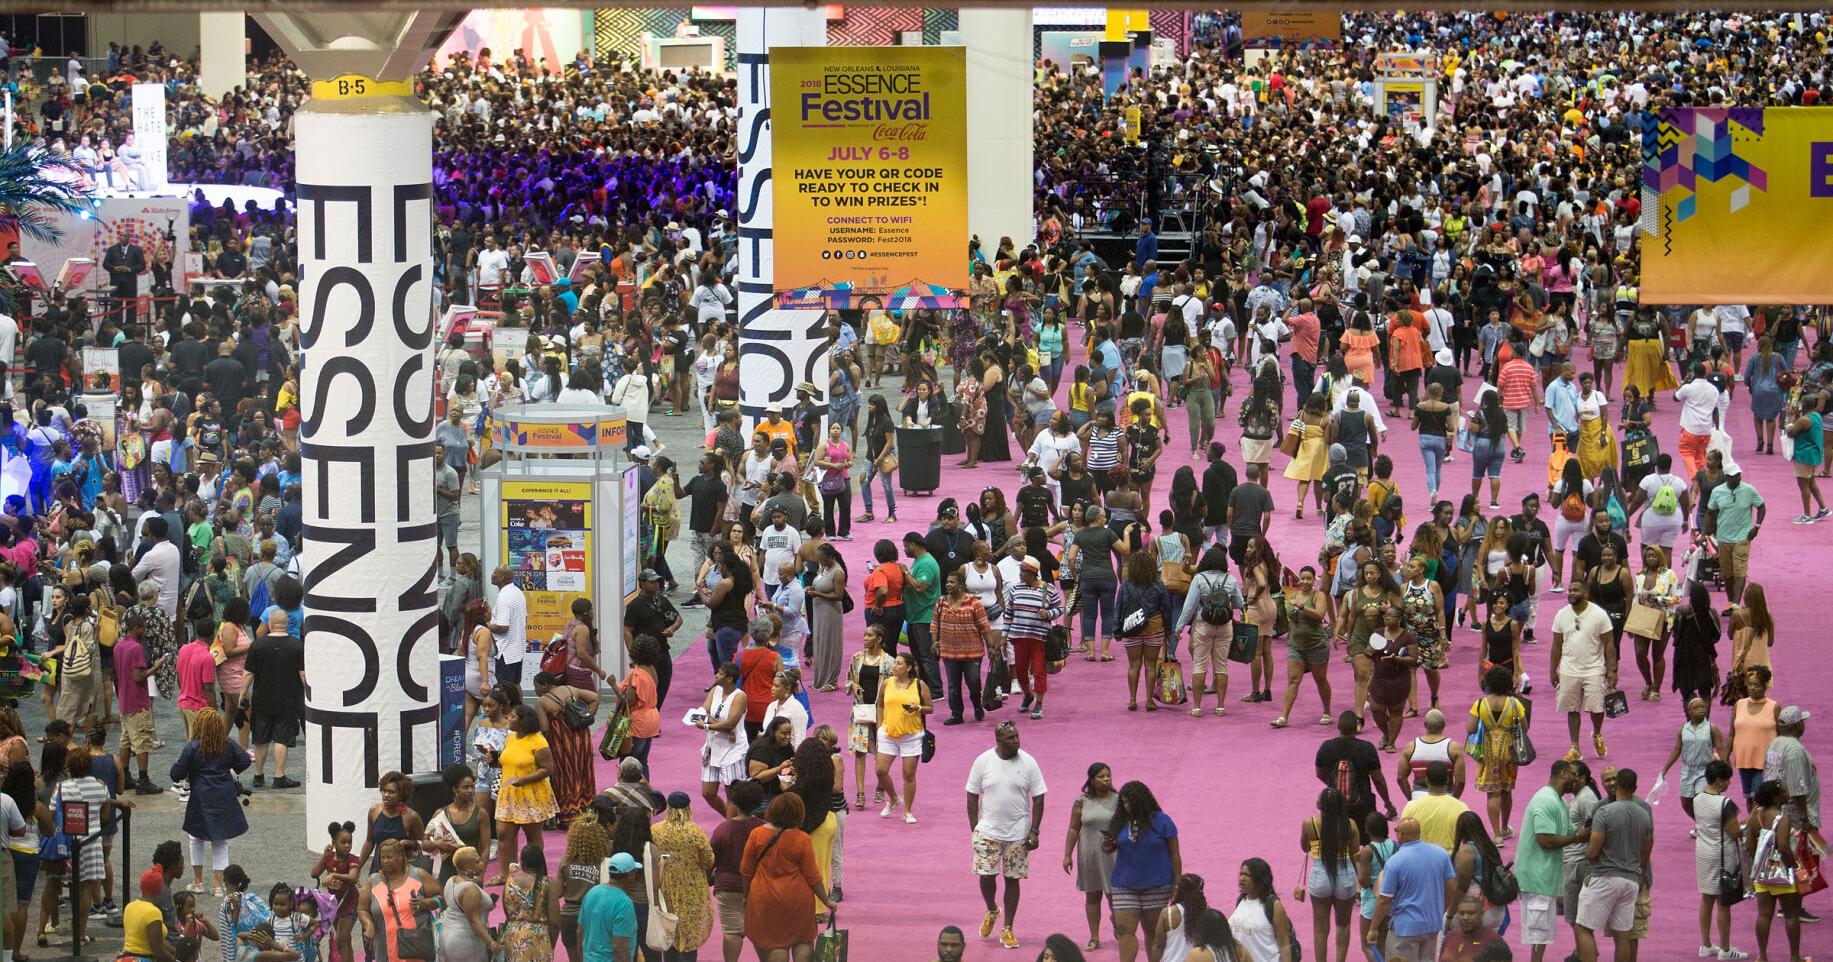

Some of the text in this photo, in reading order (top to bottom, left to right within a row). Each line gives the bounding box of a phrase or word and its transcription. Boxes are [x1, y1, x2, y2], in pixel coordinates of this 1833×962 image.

[800, 80, 821, 88] 2018
[825, 74, 920, 94] ESSENCE
[801, 92, 930, 121] Festival
[827, 146, 910, 161] JULY 6-8
[794, 168, 943, 179] HAVE YOUR QR CODE
[799, 182, 940, 193] READY TO CHECK IN
[812, 196, 830, 207] TO
[835, 196, 864, 206] WIN
[533, 431, 562, 440] Festival
[296, 183, 380, 789] ESSENCE
[1122, 608, 1145, 632] NIKE
[453, 729, 461, 764] #DREA
